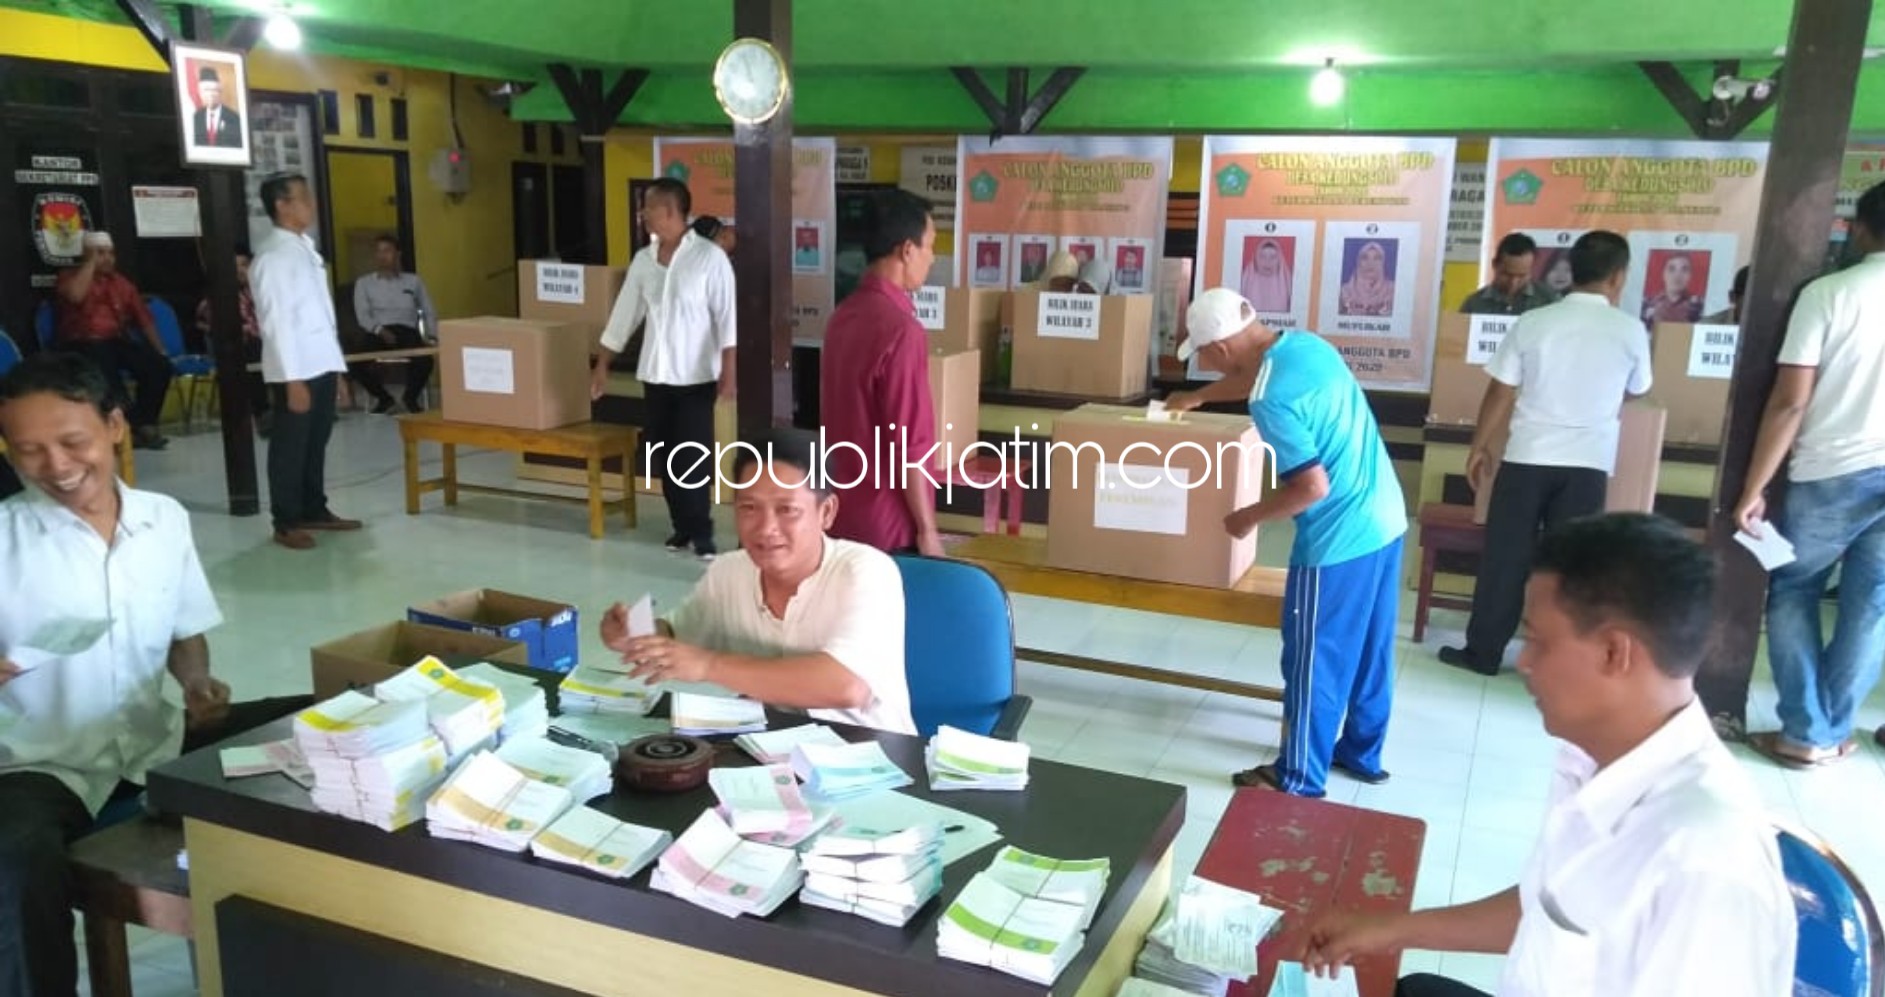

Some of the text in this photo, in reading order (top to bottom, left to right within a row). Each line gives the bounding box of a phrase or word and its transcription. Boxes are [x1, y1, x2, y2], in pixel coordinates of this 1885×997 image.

[1256, 152, 1309, 170] CALON
[1311, 152, 1391, 170] ANGGOTA
[1552, 158, 1757, 177] CALON ANGGOTA BPD
[1481, 321, 1507, 334] BILIK
